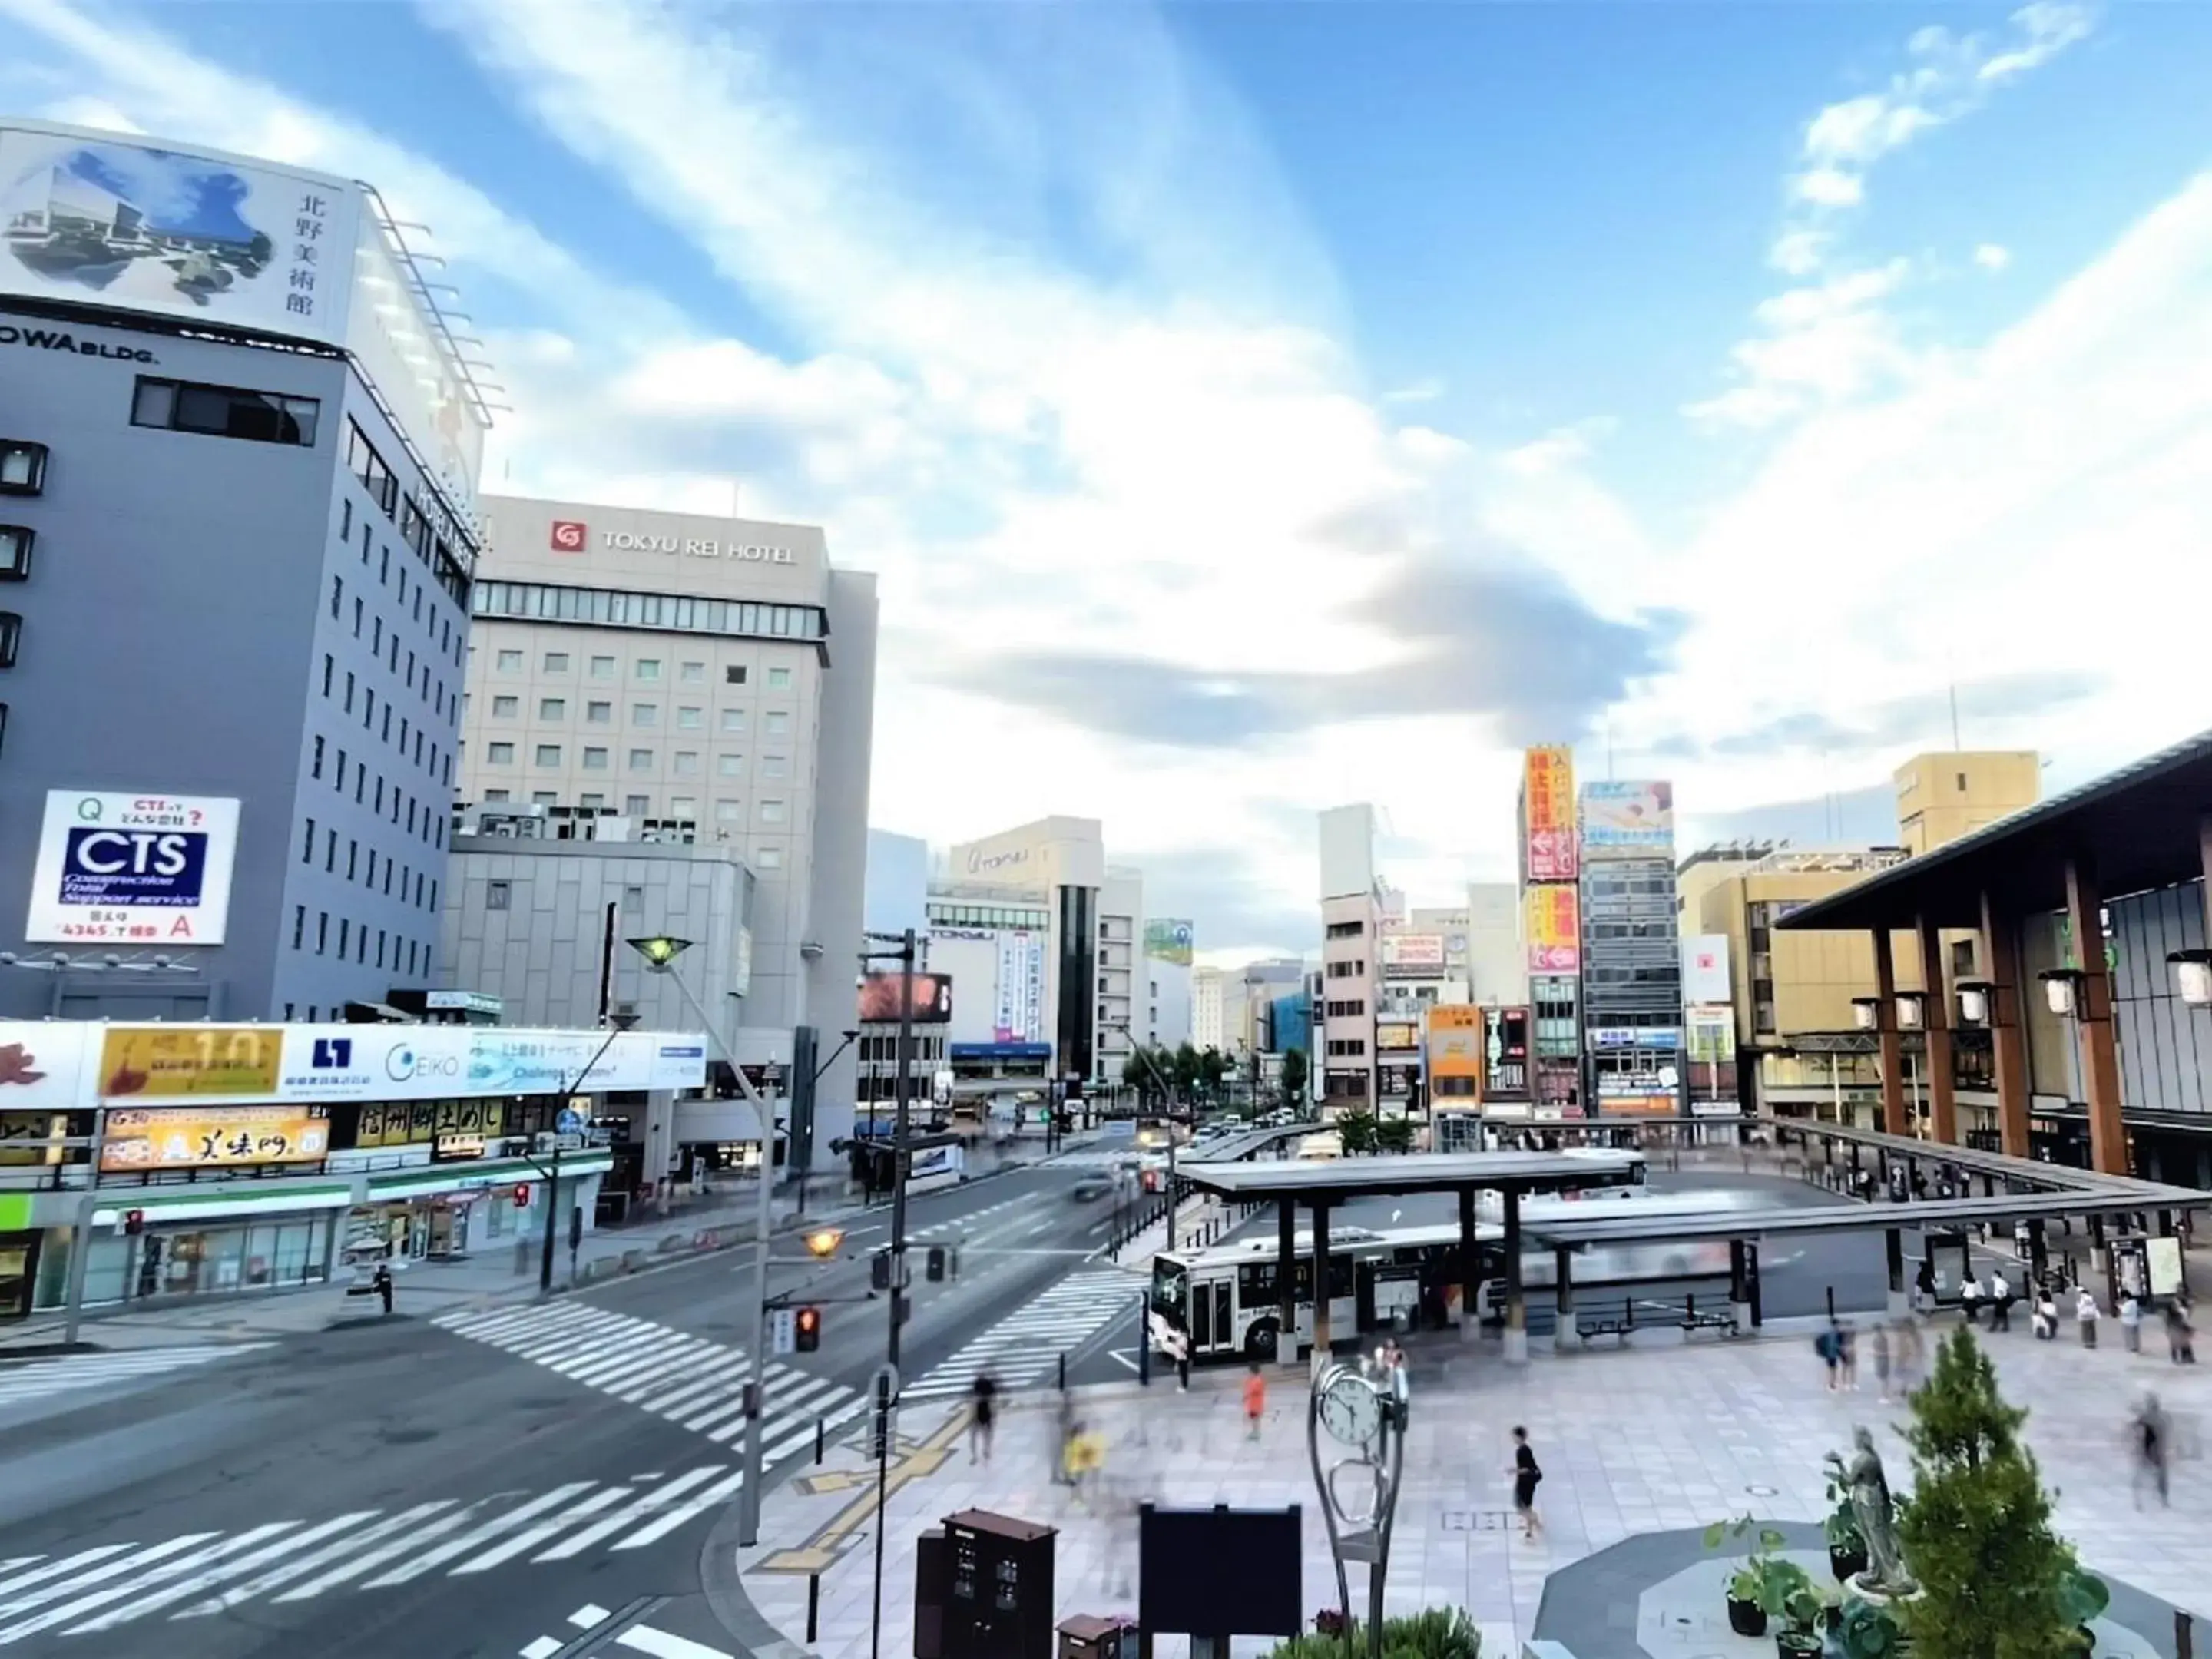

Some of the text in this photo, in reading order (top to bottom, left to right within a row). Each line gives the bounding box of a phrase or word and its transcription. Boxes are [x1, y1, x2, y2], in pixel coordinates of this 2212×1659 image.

[286, 195, 327, 316] 北野美術館
[604, 531, 796, 565] TOKYU REI HOTEL
[78, 797, 103, 821] Q
[77, 832, 187, 876] CTS
[360, 1103, 498, 1134] 信州郷土めし
